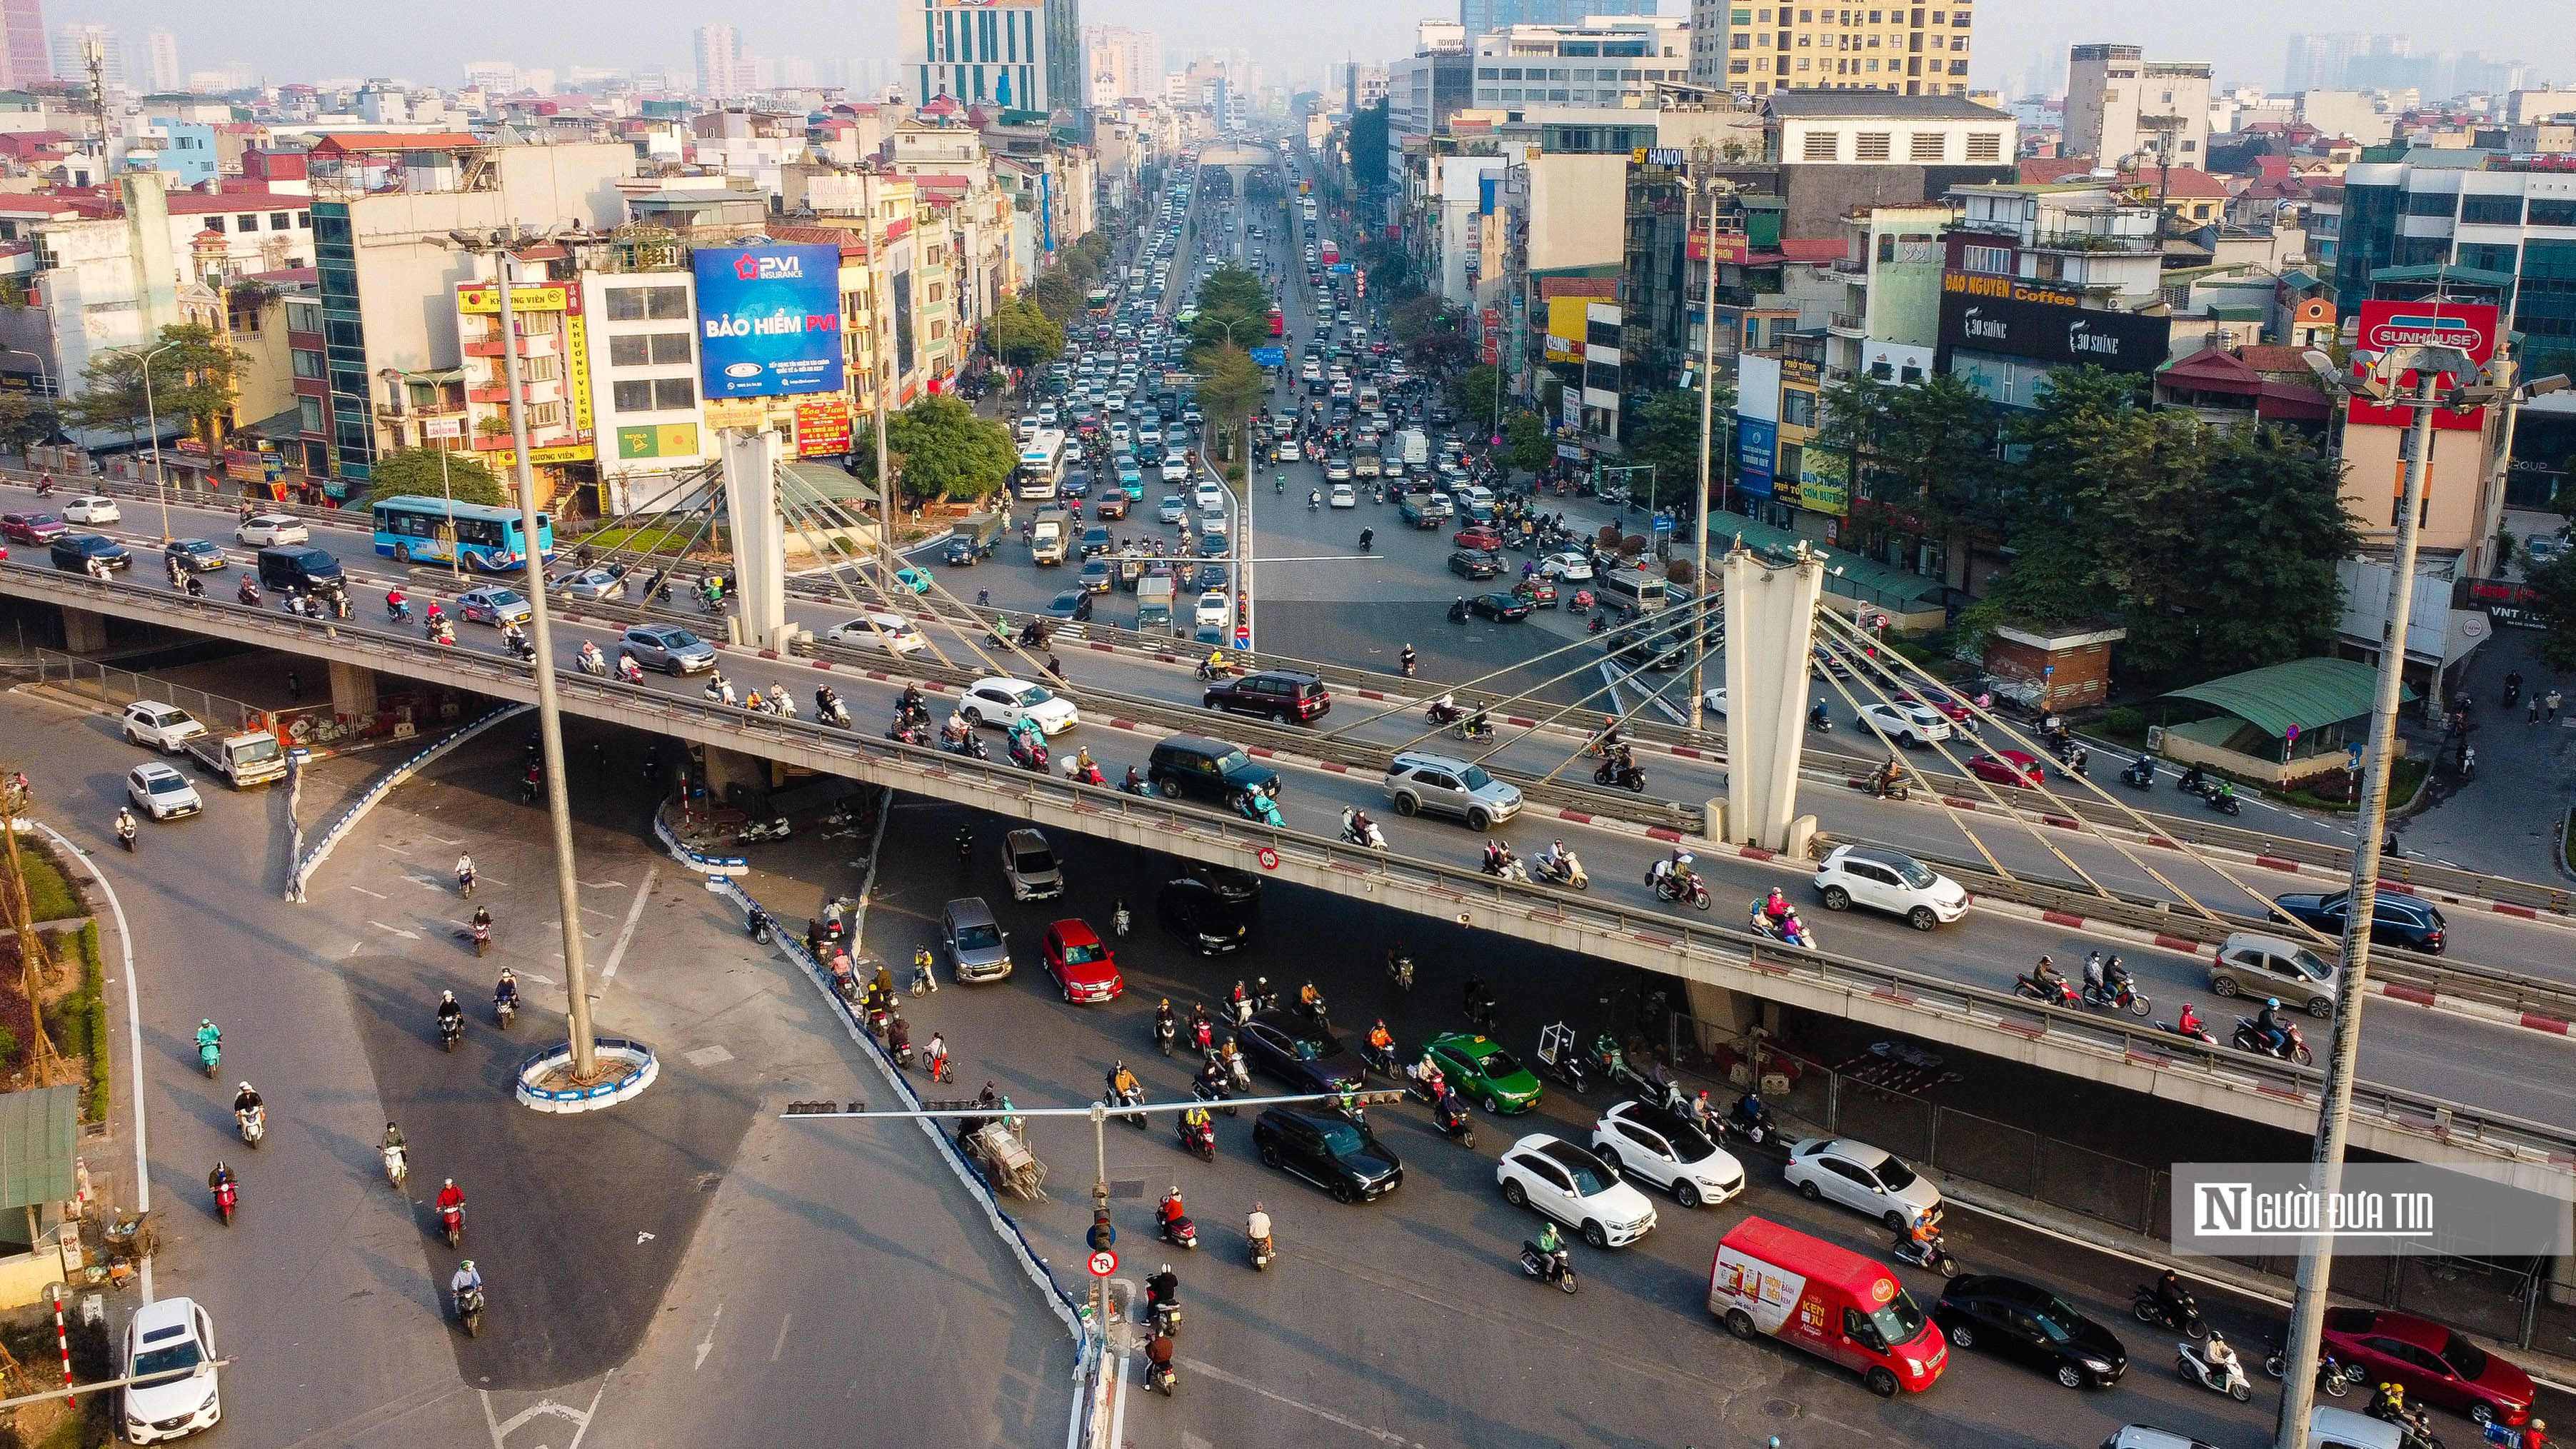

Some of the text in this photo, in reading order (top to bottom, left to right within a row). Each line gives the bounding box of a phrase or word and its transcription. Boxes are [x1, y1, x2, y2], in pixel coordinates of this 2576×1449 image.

[1649, 149, 1681, 165] HANOI
[759, 256, 799, 271] PVI
[760, 270, 803, 279] INSURANCE
[2015, 288, 2076, 306] Coffee
[1685, 303, 1695, 311] 393
[706, 307, 836, 338] BẢO HIỂM PVI
[1972, 319, 1982, 336] 30
[2078, 334, 2089, 350] 30
[2380, 331, 2472, 346] SUNHOUSE
[578, 428, 592, 438] 341
[2491, 606, 2520, 618] VNT
[1803, 1300, 1825, 1317] KEN
[1810, 1314, 1823, 1327] JU
